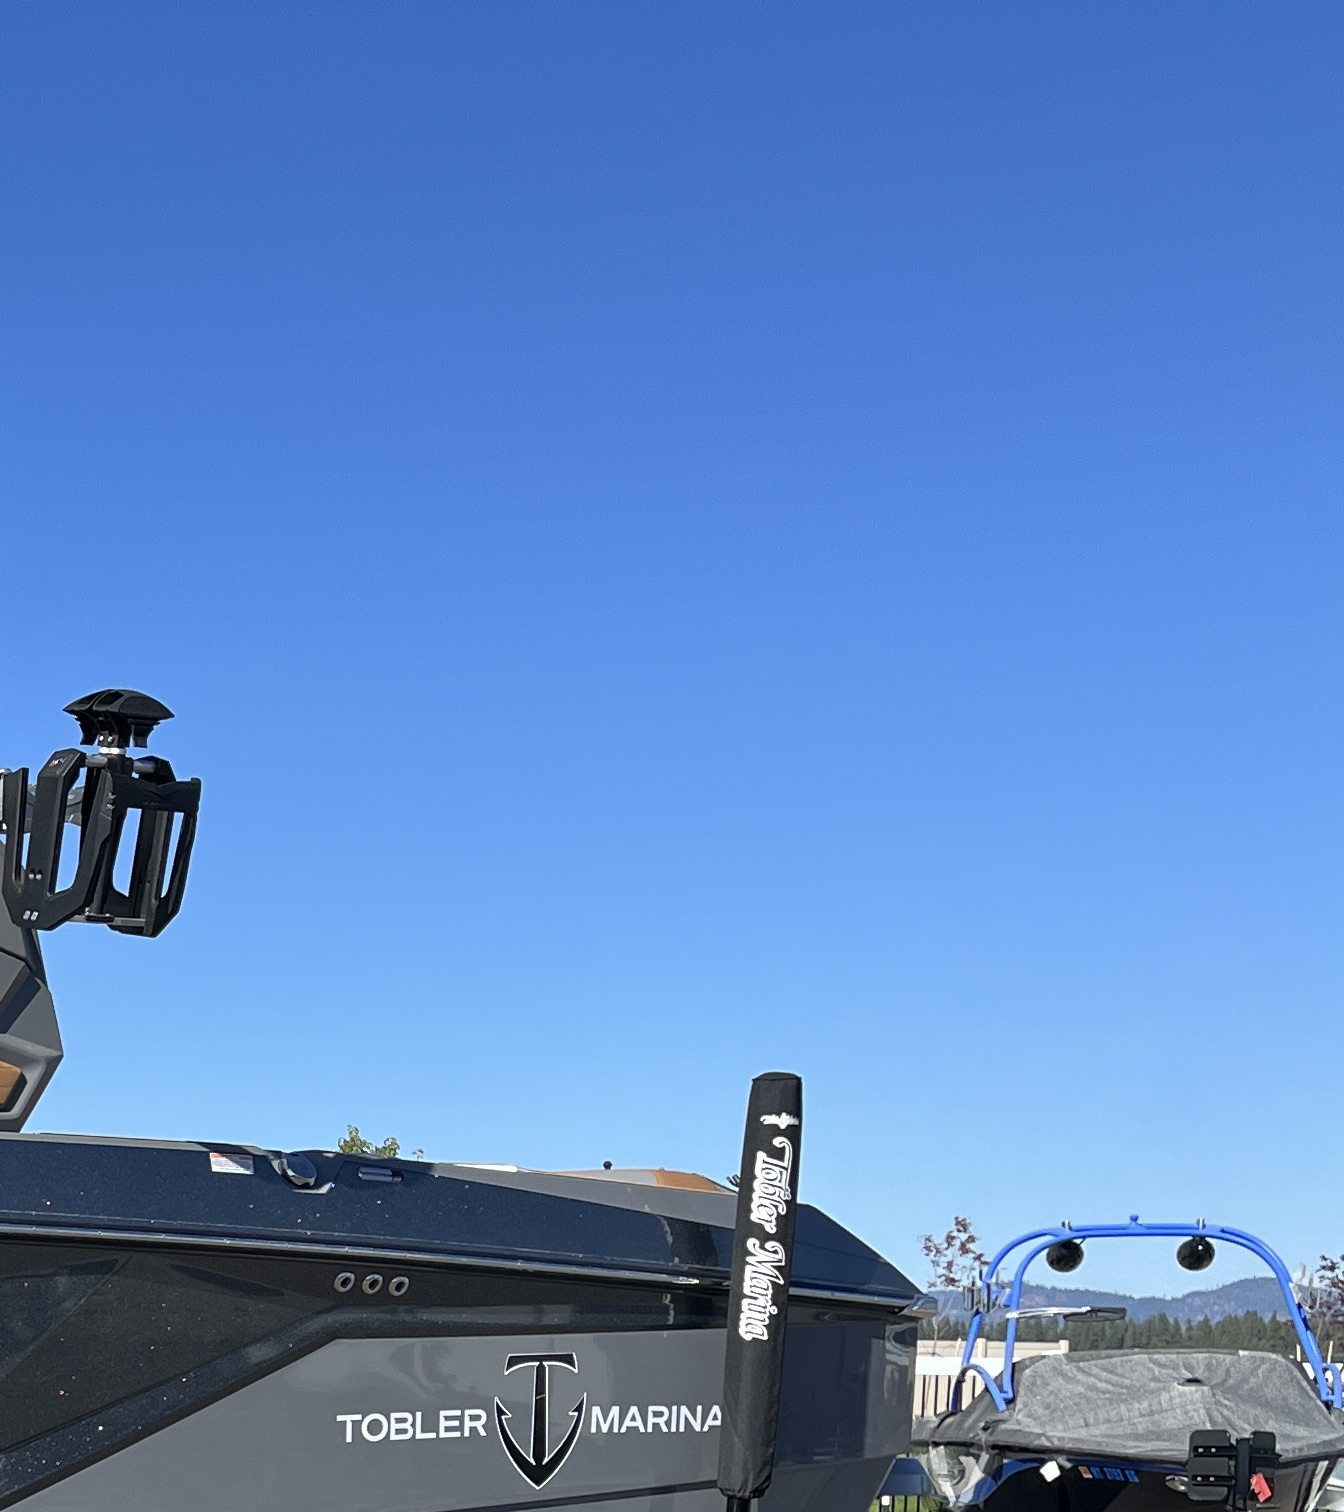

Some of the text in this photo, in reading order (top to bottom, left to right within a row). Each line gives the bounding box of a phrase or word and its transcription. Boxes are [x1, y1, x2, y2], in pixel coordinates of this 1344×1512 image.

[738, 1136, 792, 1341] Tobler Marina
[336, 1408, 488, 1443] TOBLER
[589, 1404, 723, 1434] MARINA
